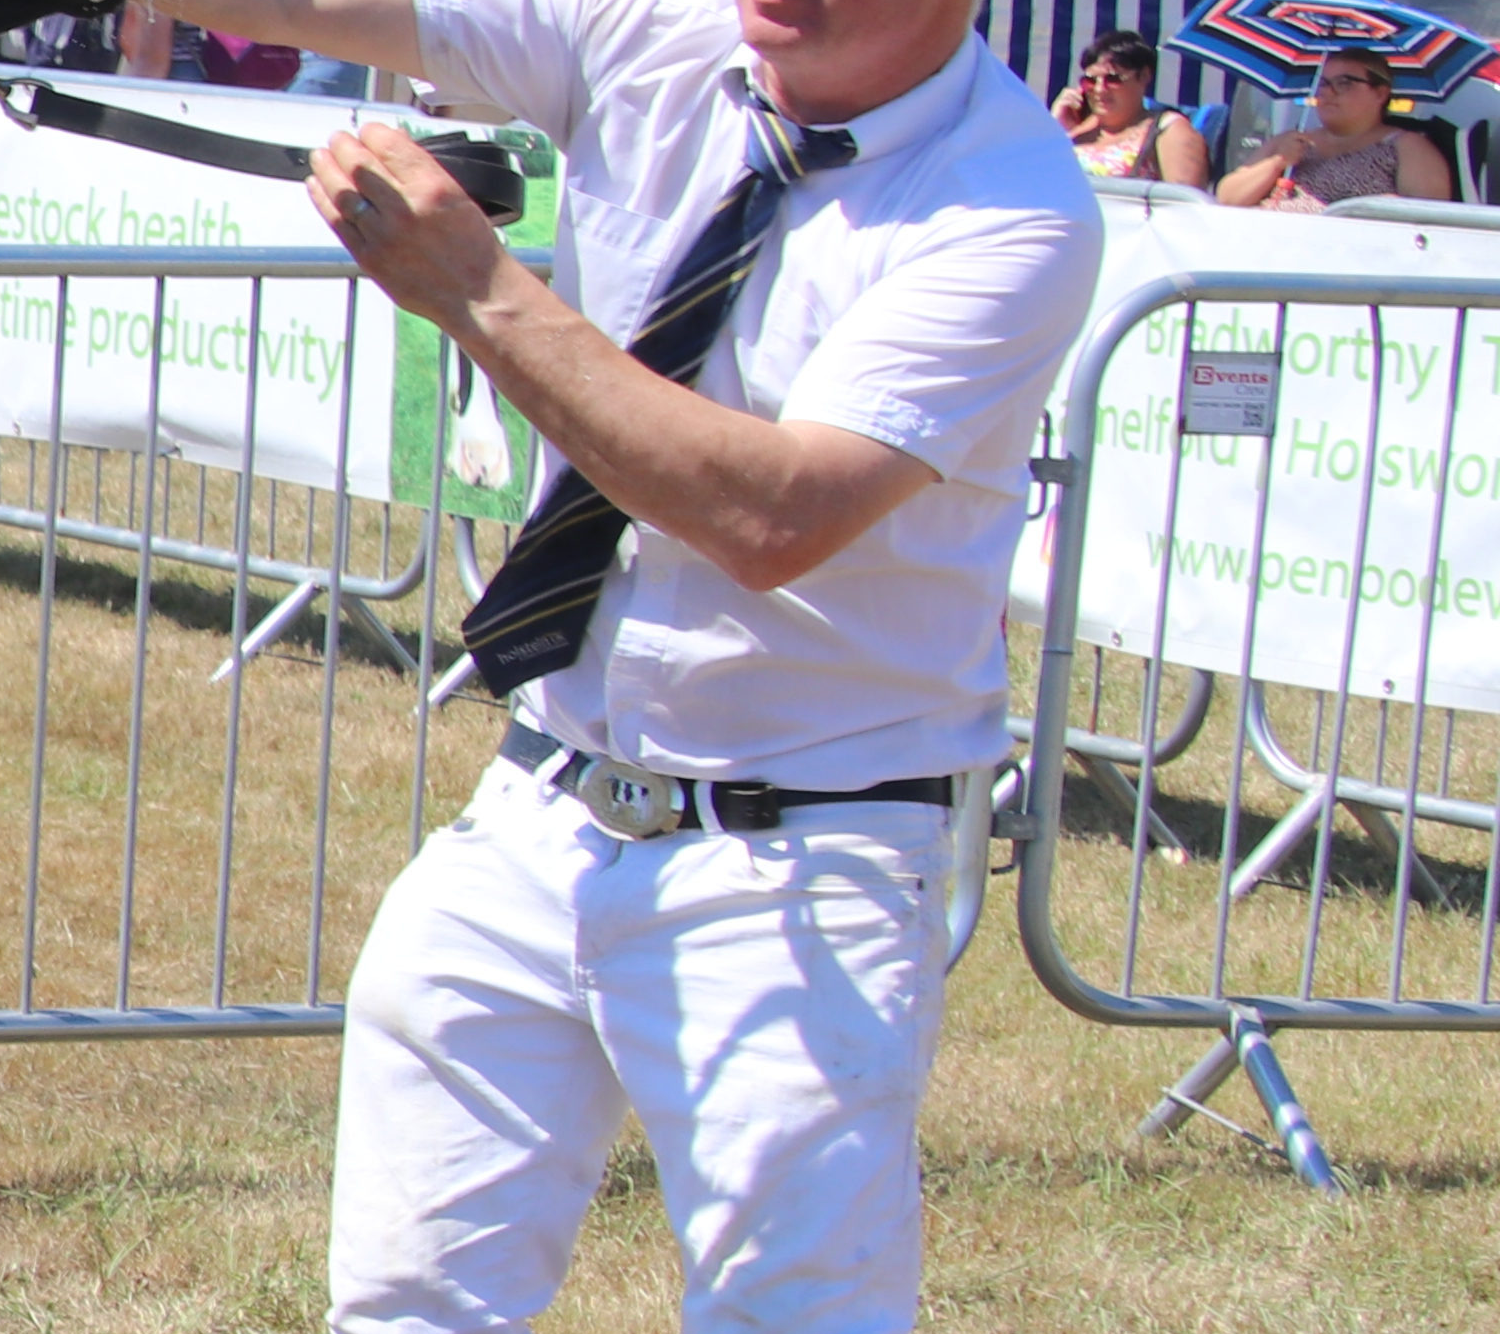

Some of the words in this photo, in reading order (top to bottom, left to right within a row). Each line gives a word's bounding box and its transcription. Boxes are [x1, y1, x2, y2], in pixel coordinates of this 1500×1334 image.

[118, 190, 243, 247] health
[87, 298, 347, 404] productvity
[1193, 365, 1269, 385] Events
[1286, 417, 1500, 500] Hoswor
